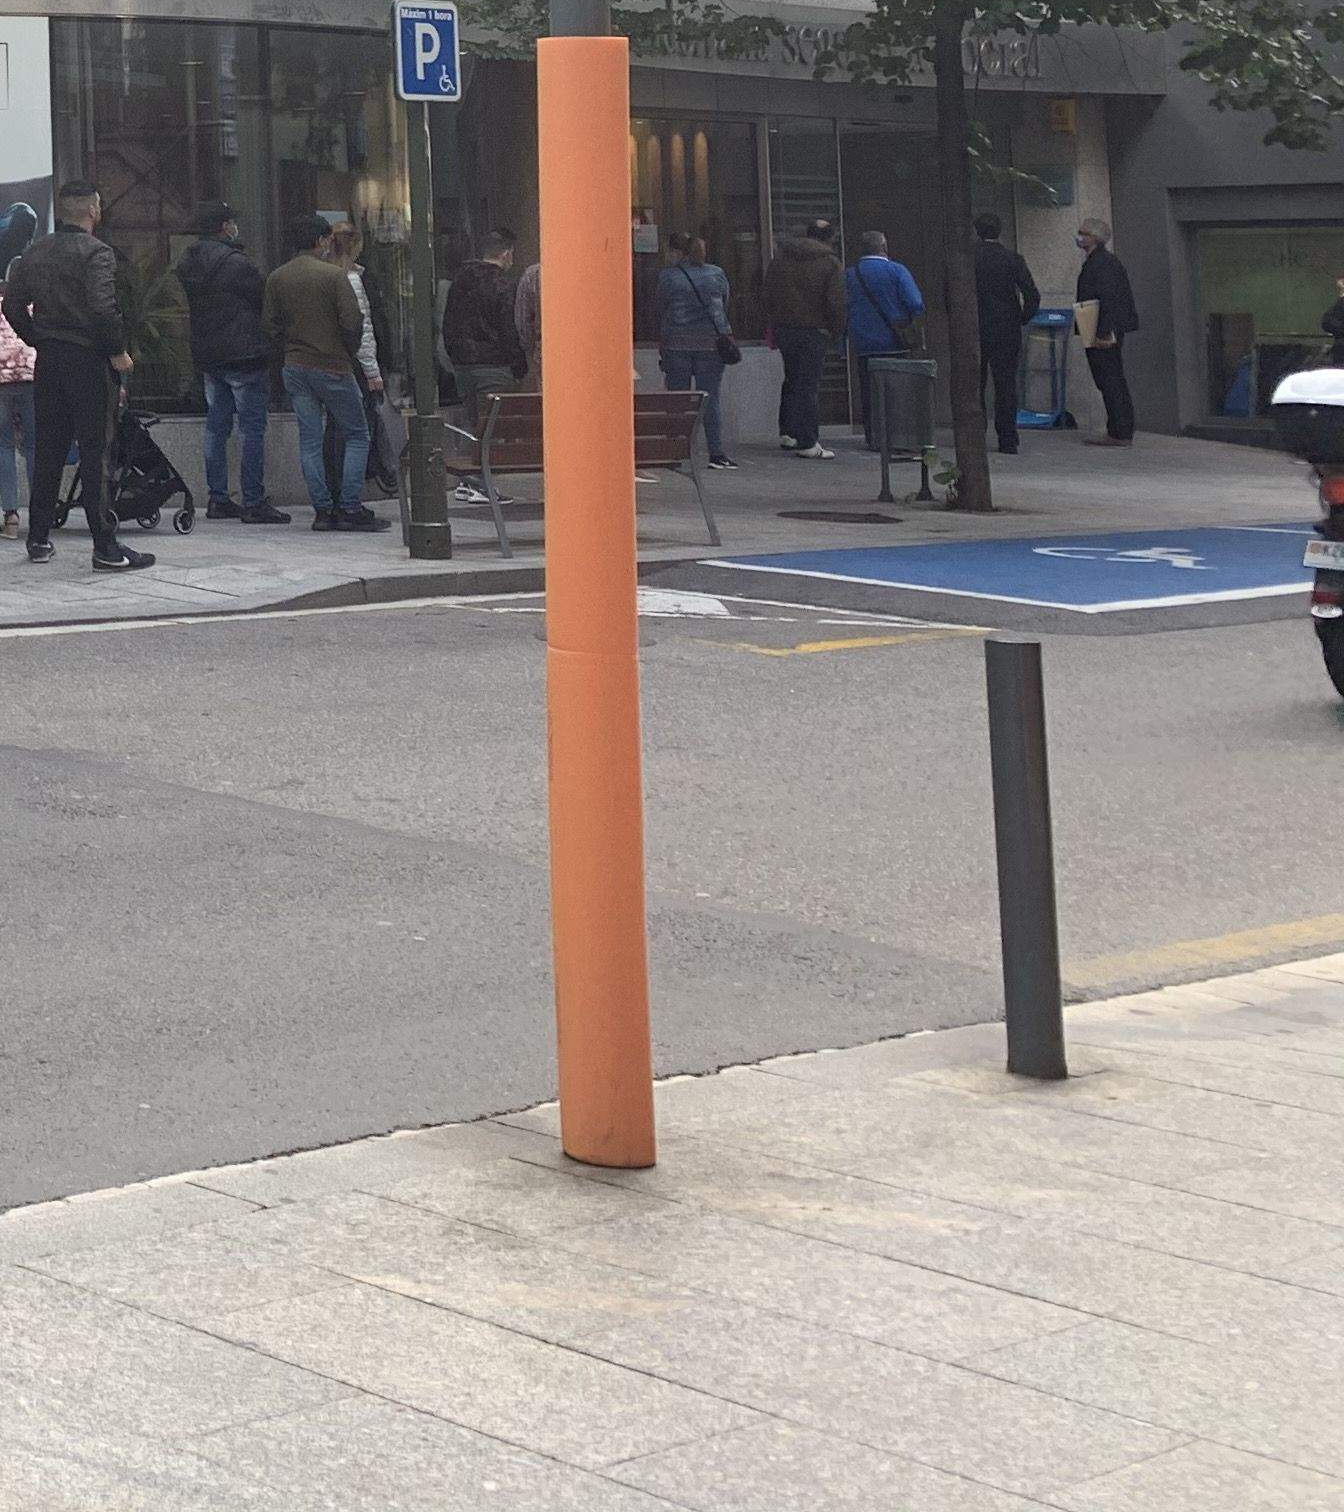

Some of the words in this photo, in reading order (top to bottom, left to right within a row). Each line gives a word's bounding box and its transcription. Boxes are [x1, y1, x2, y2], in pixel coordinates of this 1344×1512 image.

[428, 10, 433, 20] 1
[434, 10, 453, 21] hora
[415, 22, 441, 80] P
